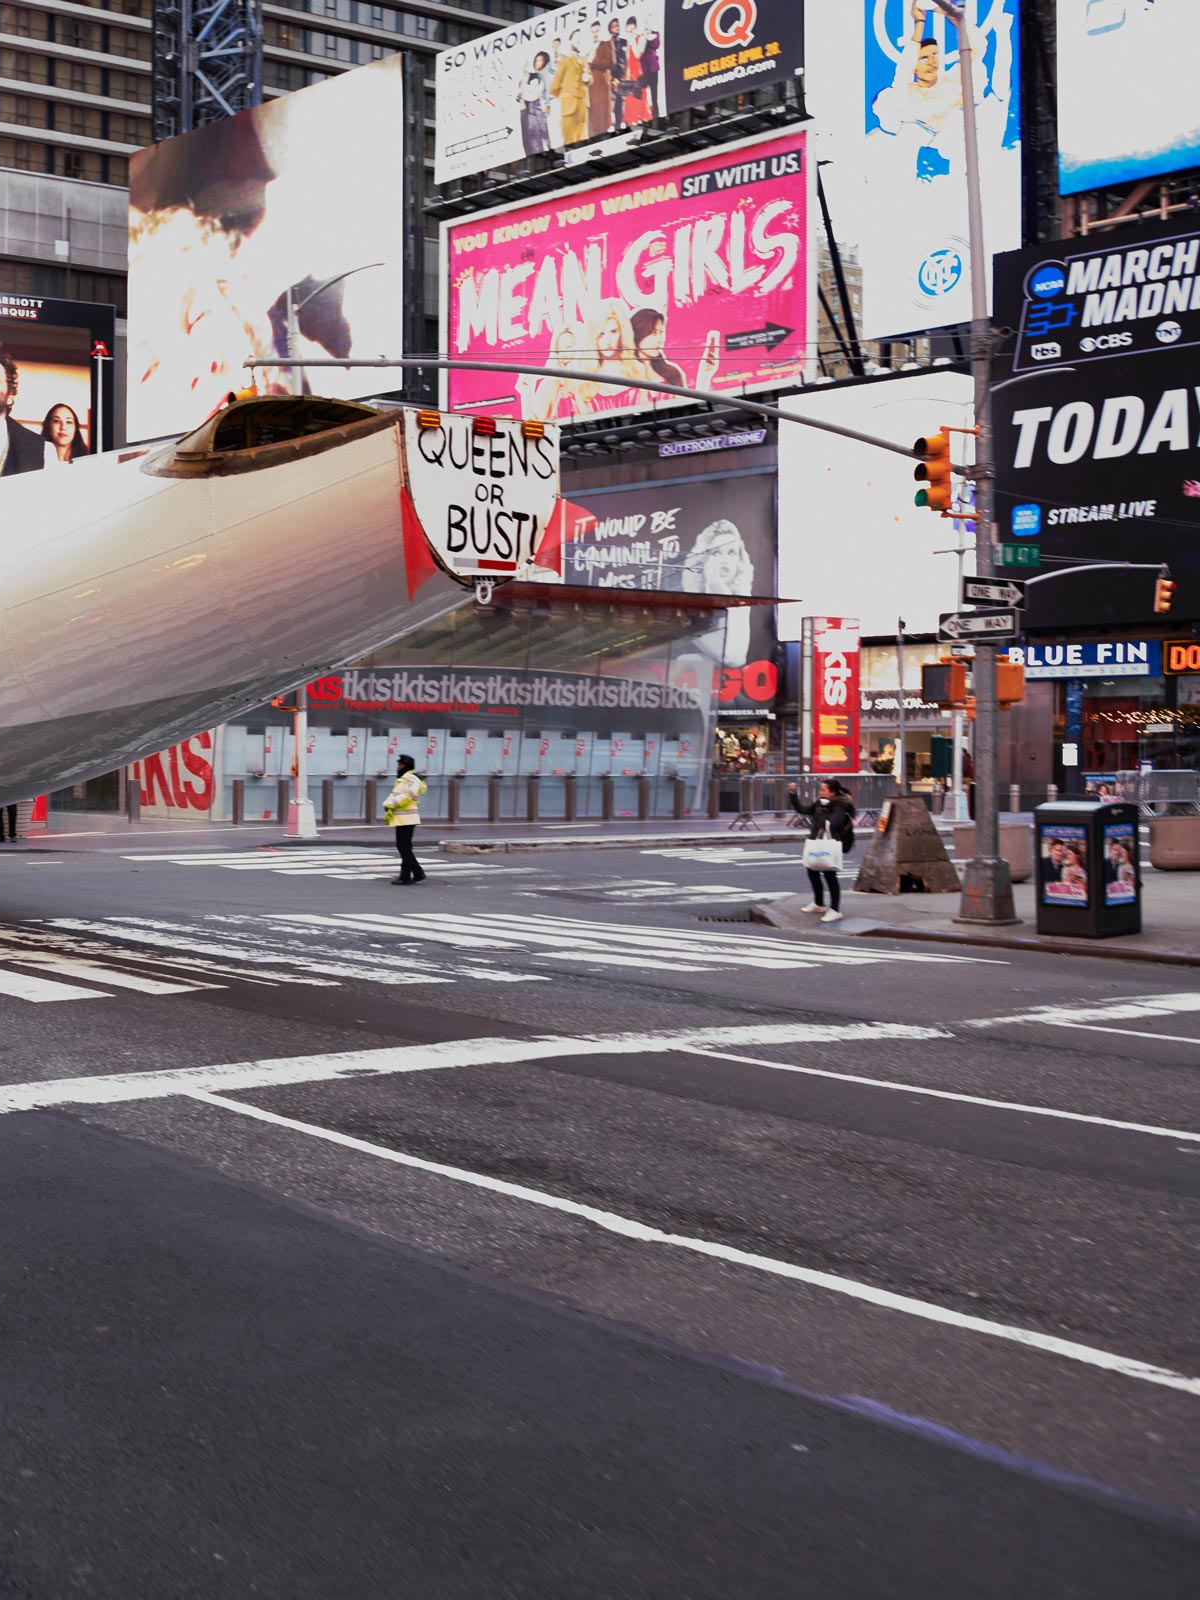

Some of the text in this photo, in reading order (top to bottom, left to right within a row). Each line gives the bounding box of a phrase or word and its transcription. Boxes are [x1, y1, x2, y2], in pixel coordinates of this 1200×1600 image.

[444, 51, 467, 73] SO
[473, 21, 546, 61] WRONG
[554, 6, 588, 32] IT'S
[689, 59, 777, 92] AvenueQ.com
[452, 236, 488, 255] YOU
[492, 215, 551, 247] KNOW
[555, 204, 597, 229] YOU
[599, 183, 679, 215] WANNA
[681, 174, 711, 198] SIT
[714, 162, 767, 190] WITH
[458, 200, 801, 354] MEAN GIRLS
[1066, 239, 1200, 295] MARCH
[1034, 279, 1064, 292] NCAA
[1096, 332, 1134, 349] CBS
[1011, 386, 1200, 469] TODA
[418, 425, 556, 480] QUEENS
[661, 431, 763, 455] OUTFRONT PRIME
[475, 483, 504, 507] OR
[1047, 504, 1115, 525] STREAM
[1118, 500, 1157, 518] LIVE
[574, 508, 682, 543] IT WOULD BE
[657, 535, 680, 558] TO
[971, 585, 1017, 600] ONE WAY
[947, 616, 1009, 632] ONE WAY
[1008, 641, 1147, 667] BLUE FIN
[385, 699, 451, 713] Development
[309, 735, 317, 748] 2
[351, 735, 358, 748] 3
[390, 736, 398, 748] 4
[430, 736, 437, 749] 5
[468, 737, 476, 749] 6
[505, 737, 513, 749] 7
[542, 738, 550, 751] 8
